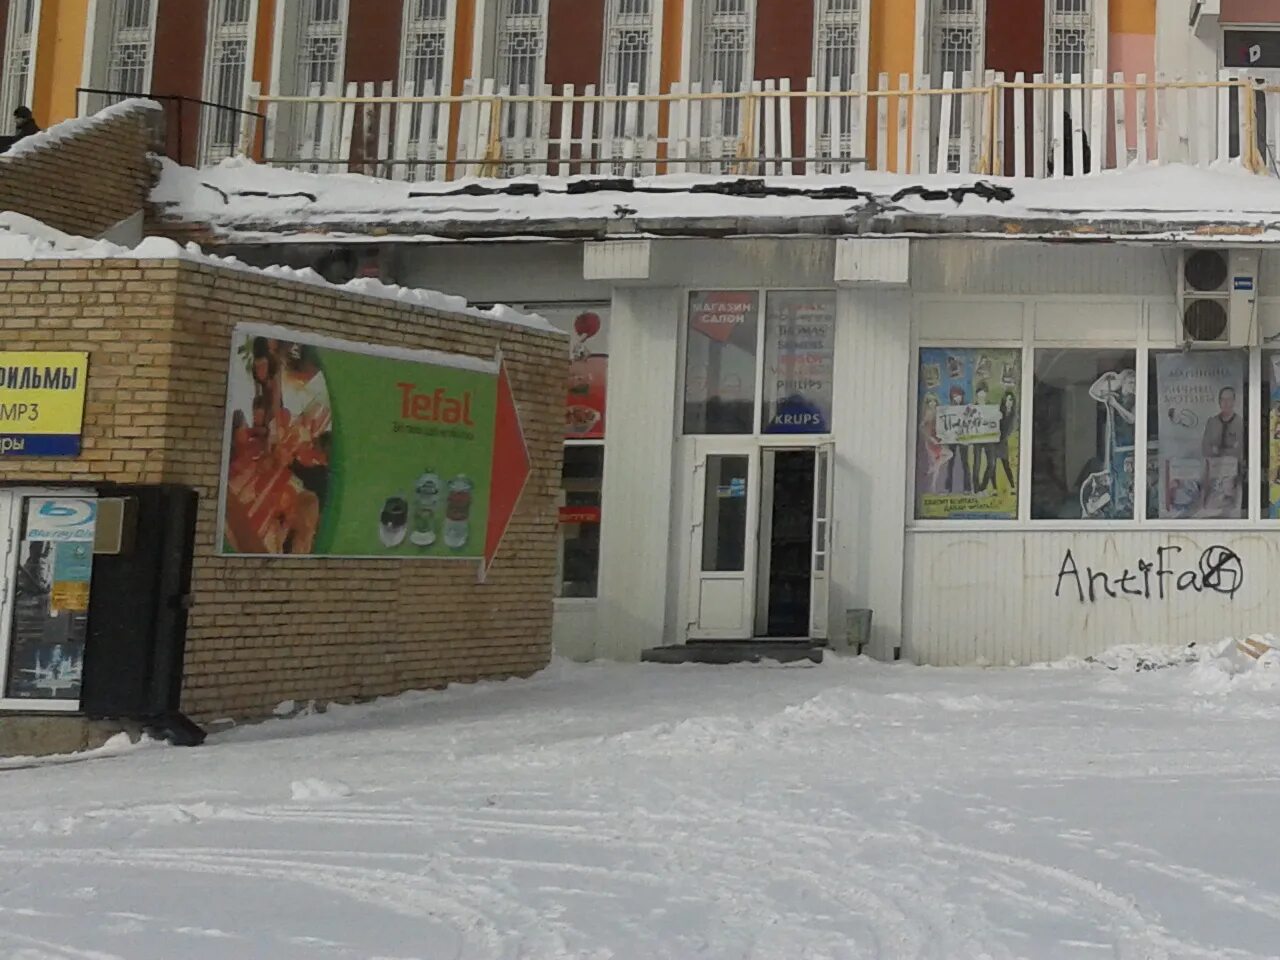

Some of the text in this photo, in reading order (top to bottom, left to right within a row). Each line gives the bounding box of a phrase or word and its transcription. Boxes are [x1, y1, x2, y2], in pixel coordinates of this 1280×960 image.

[0, 403, 39, 422] MP3
[396, 382, 475, 428] Tefal
[774, 413, 821, 425] KRUPS
[0, 437, 26, 455] ры
